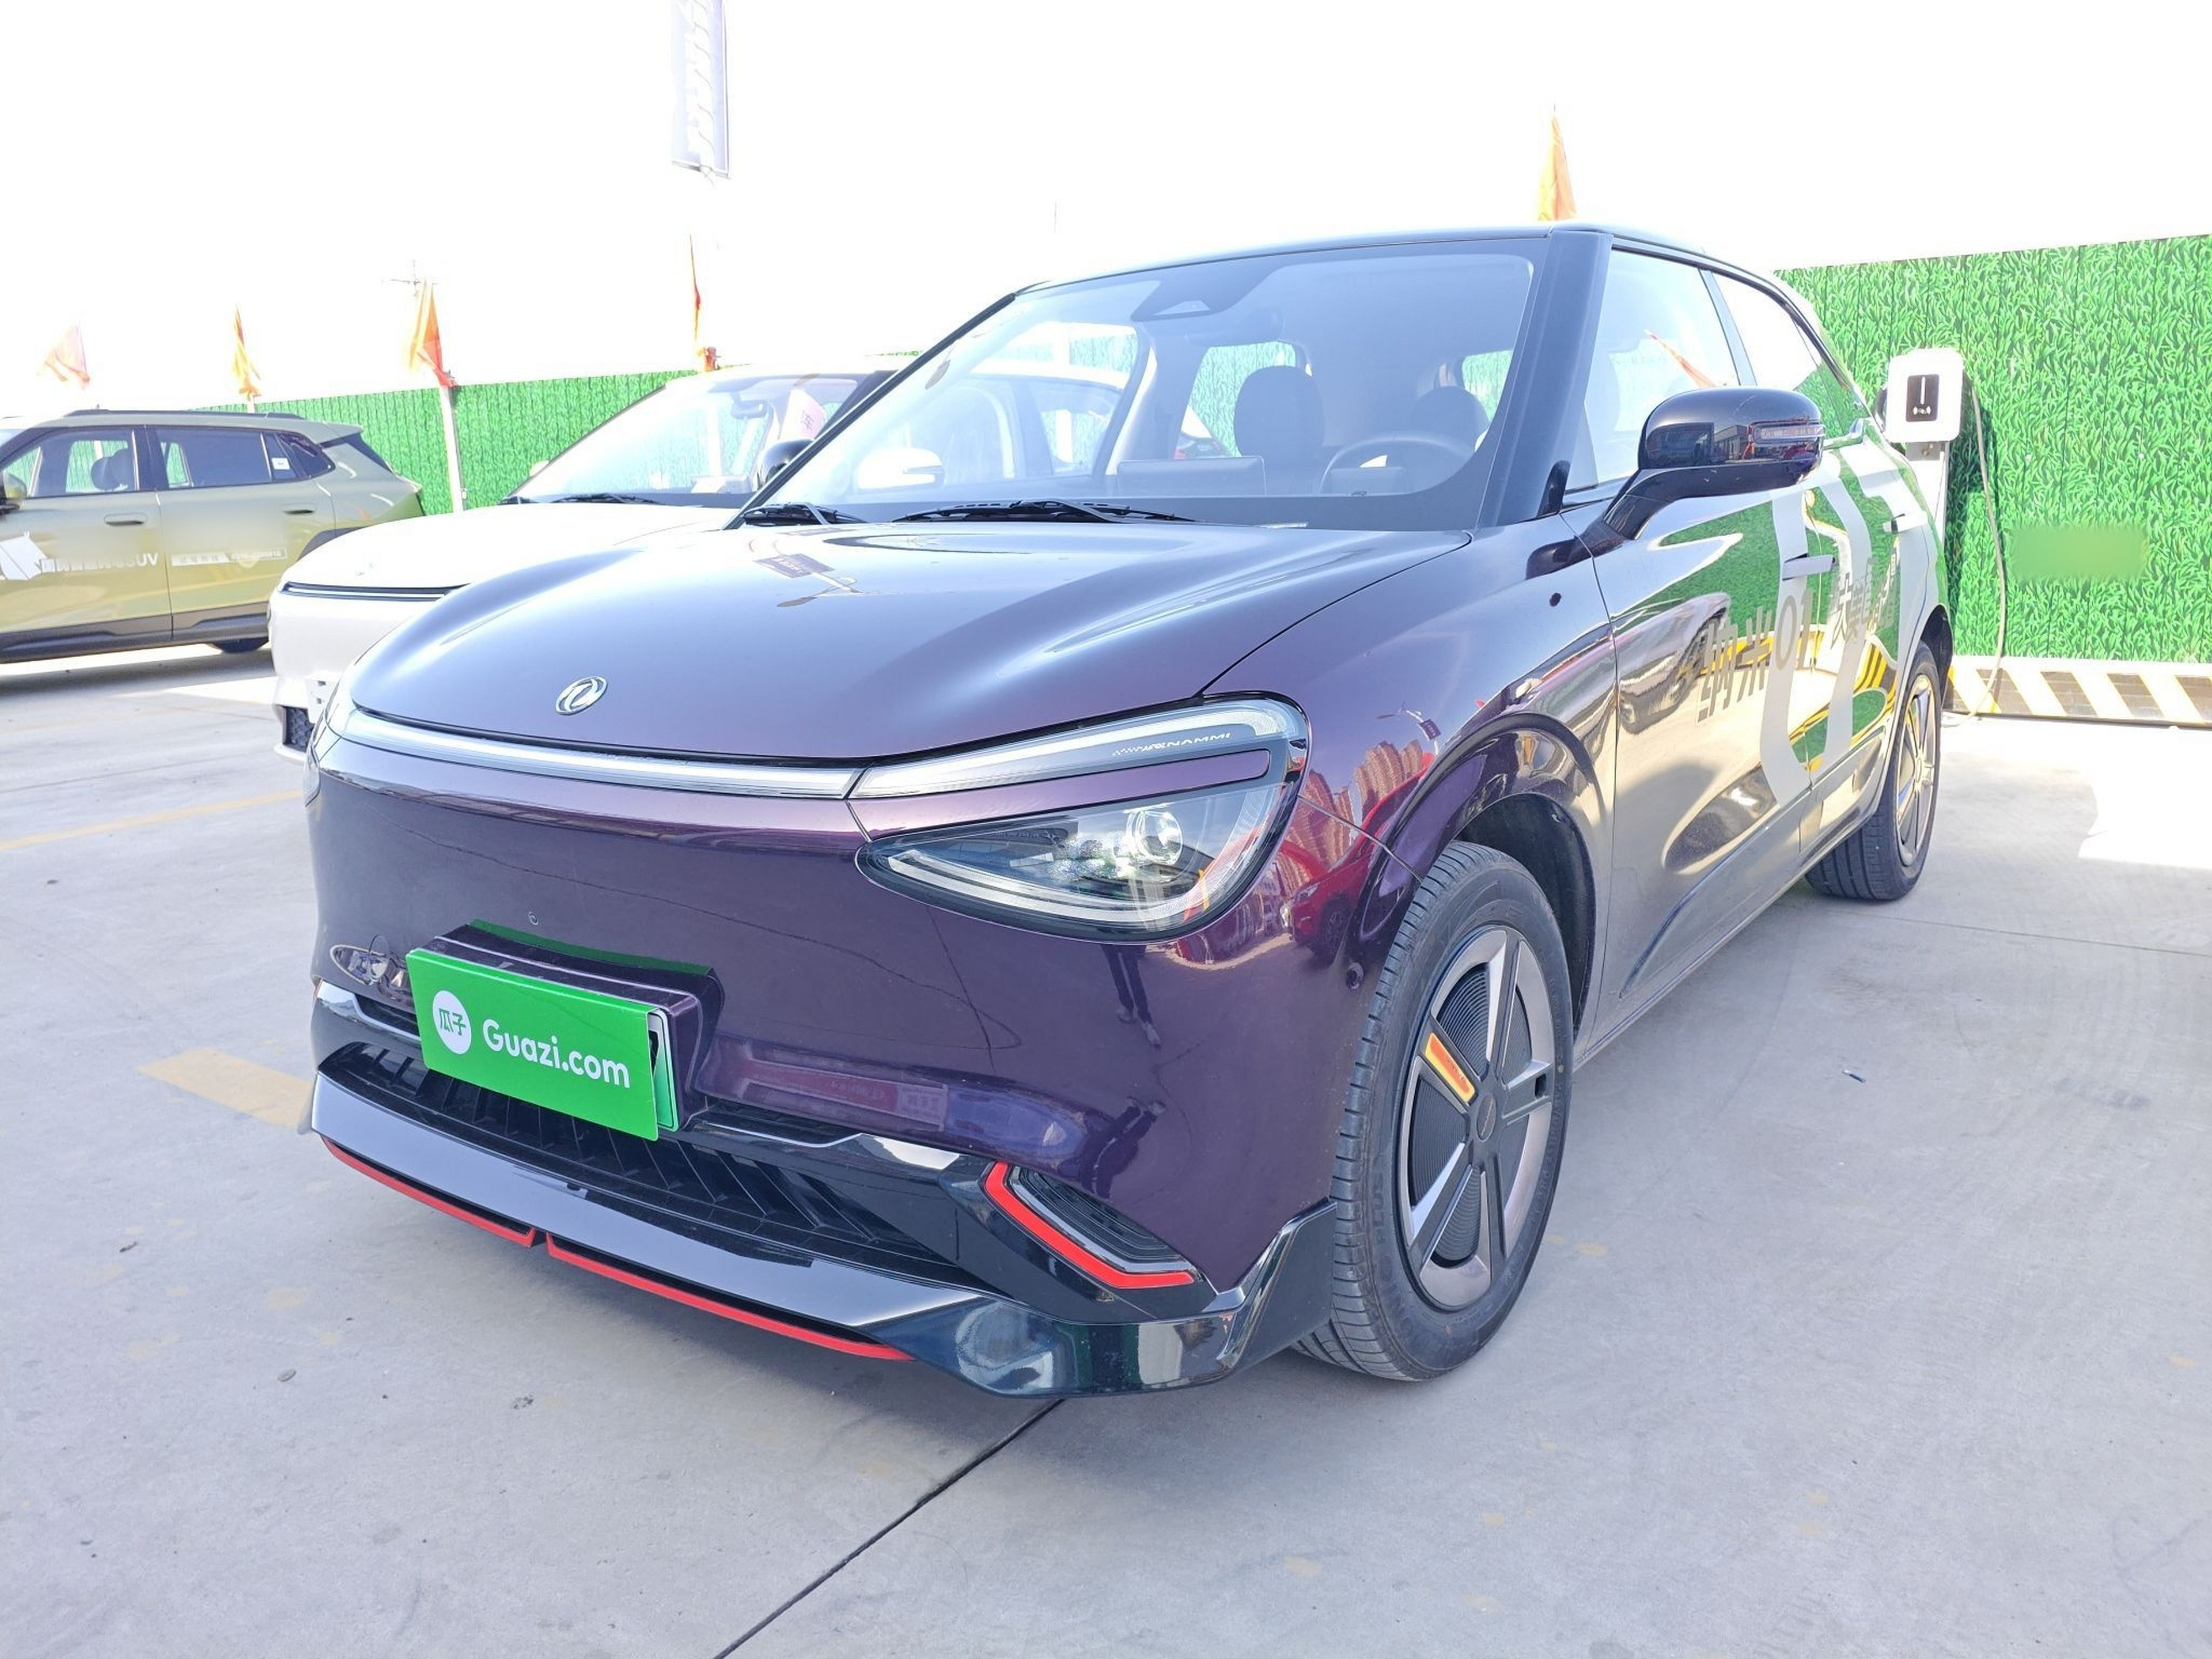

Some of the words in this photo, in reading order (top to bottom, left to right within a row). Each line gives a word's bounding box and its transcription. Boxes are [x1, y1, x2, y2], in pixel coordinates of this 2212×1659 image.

[1166, 732, 1231, 747] NAMMI
[438, 1007, 467, 1036] 瓜子
[482, 1018, 631, 1089] Guazi.com
